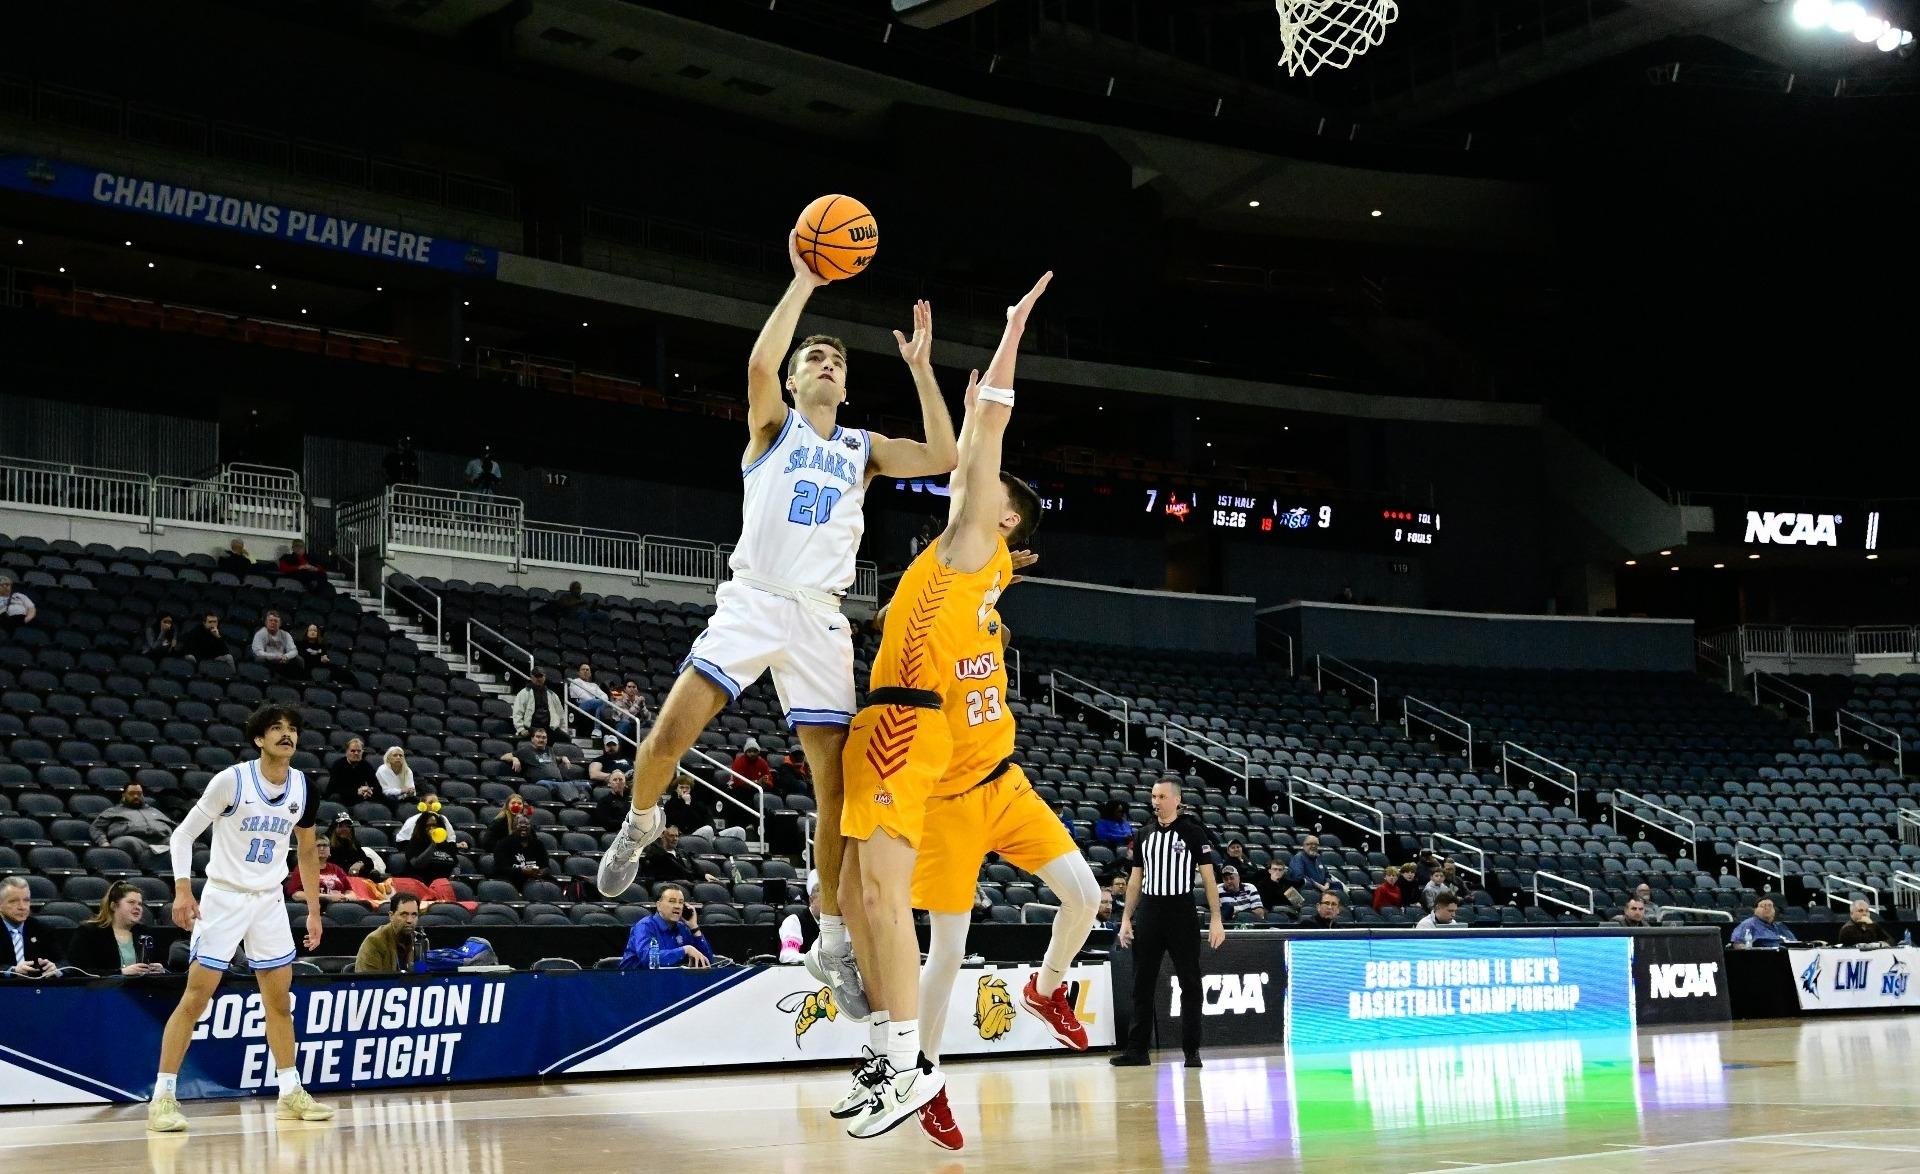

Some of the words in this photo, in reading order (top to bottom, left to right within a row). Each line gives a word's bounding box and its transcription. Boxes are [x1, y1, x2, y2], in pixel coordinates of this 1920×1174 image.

[93, 172, 280, 233] CHAMPIONS
[286, 210, 358, 248] PLAY
[361, 225, 433, 263] HERE
[546, 472, 568, 486] 117
[784, 445, 857, 486] SHARKS
[787, 479, 842, 526] 20
[1145, 489, 1158, 513] 7
[1234, 496, 1257, 509] HALF
[1212, 509, 1247, 528] 15:26
[1317, 505, 1332, 529] 9
[1407, 532, 1433, 545] FOULS
[955, 651, 999, 681] UMSL
[966, 685, 1003, 728] 23
[245, 837, 276, 865] 13
[1365, 961, 1412, 990] 2023
[1416, 959, 1490, 988] DIVISION
[1510, 957, 1560, 985] MEN'S
[1834, 958, 1872, 992] LMU
[1880, 973, 1908, 998] NSU
[191, 992, 298, 1040] 202
[306, 985, 471, 1034] DIVISION
[478, 982, 505, 1025] II
[1349, 989, 1456, 1020] BASKETBALL
[1459, 984, 1580, 1015] CHAMPIONSHIP
[351, 1032, 461, 1081] EIGHT
